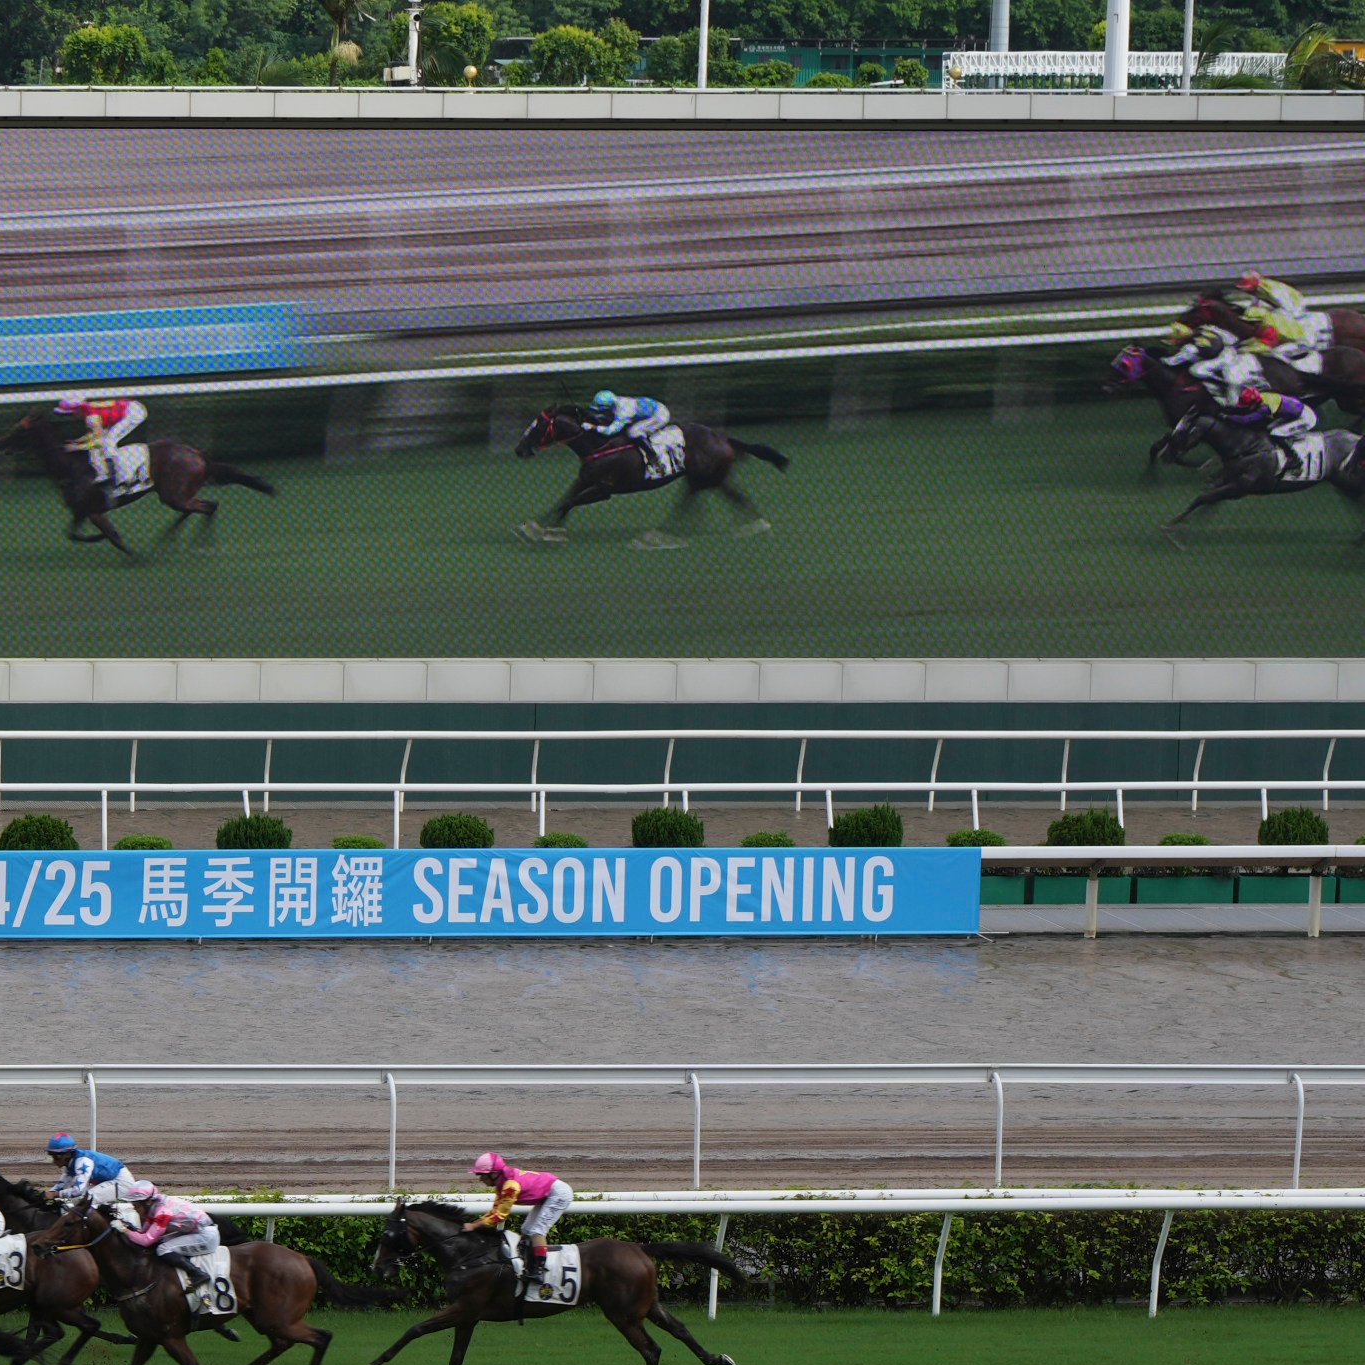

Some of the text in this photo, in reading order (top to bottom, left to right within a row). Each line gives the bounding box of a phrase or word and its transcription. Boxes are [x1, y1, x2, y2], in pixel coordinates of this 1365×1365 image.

[138, 853, 384, 928] 馬季開鑼
[412, 856, 626, 924] SEASON
[649, 855, 894, 923] OPENING
[6, 1251, 23, 1287] 3
[558, 1266, 577, 1303] 5
[214, 1277, 235, 1312] 8
